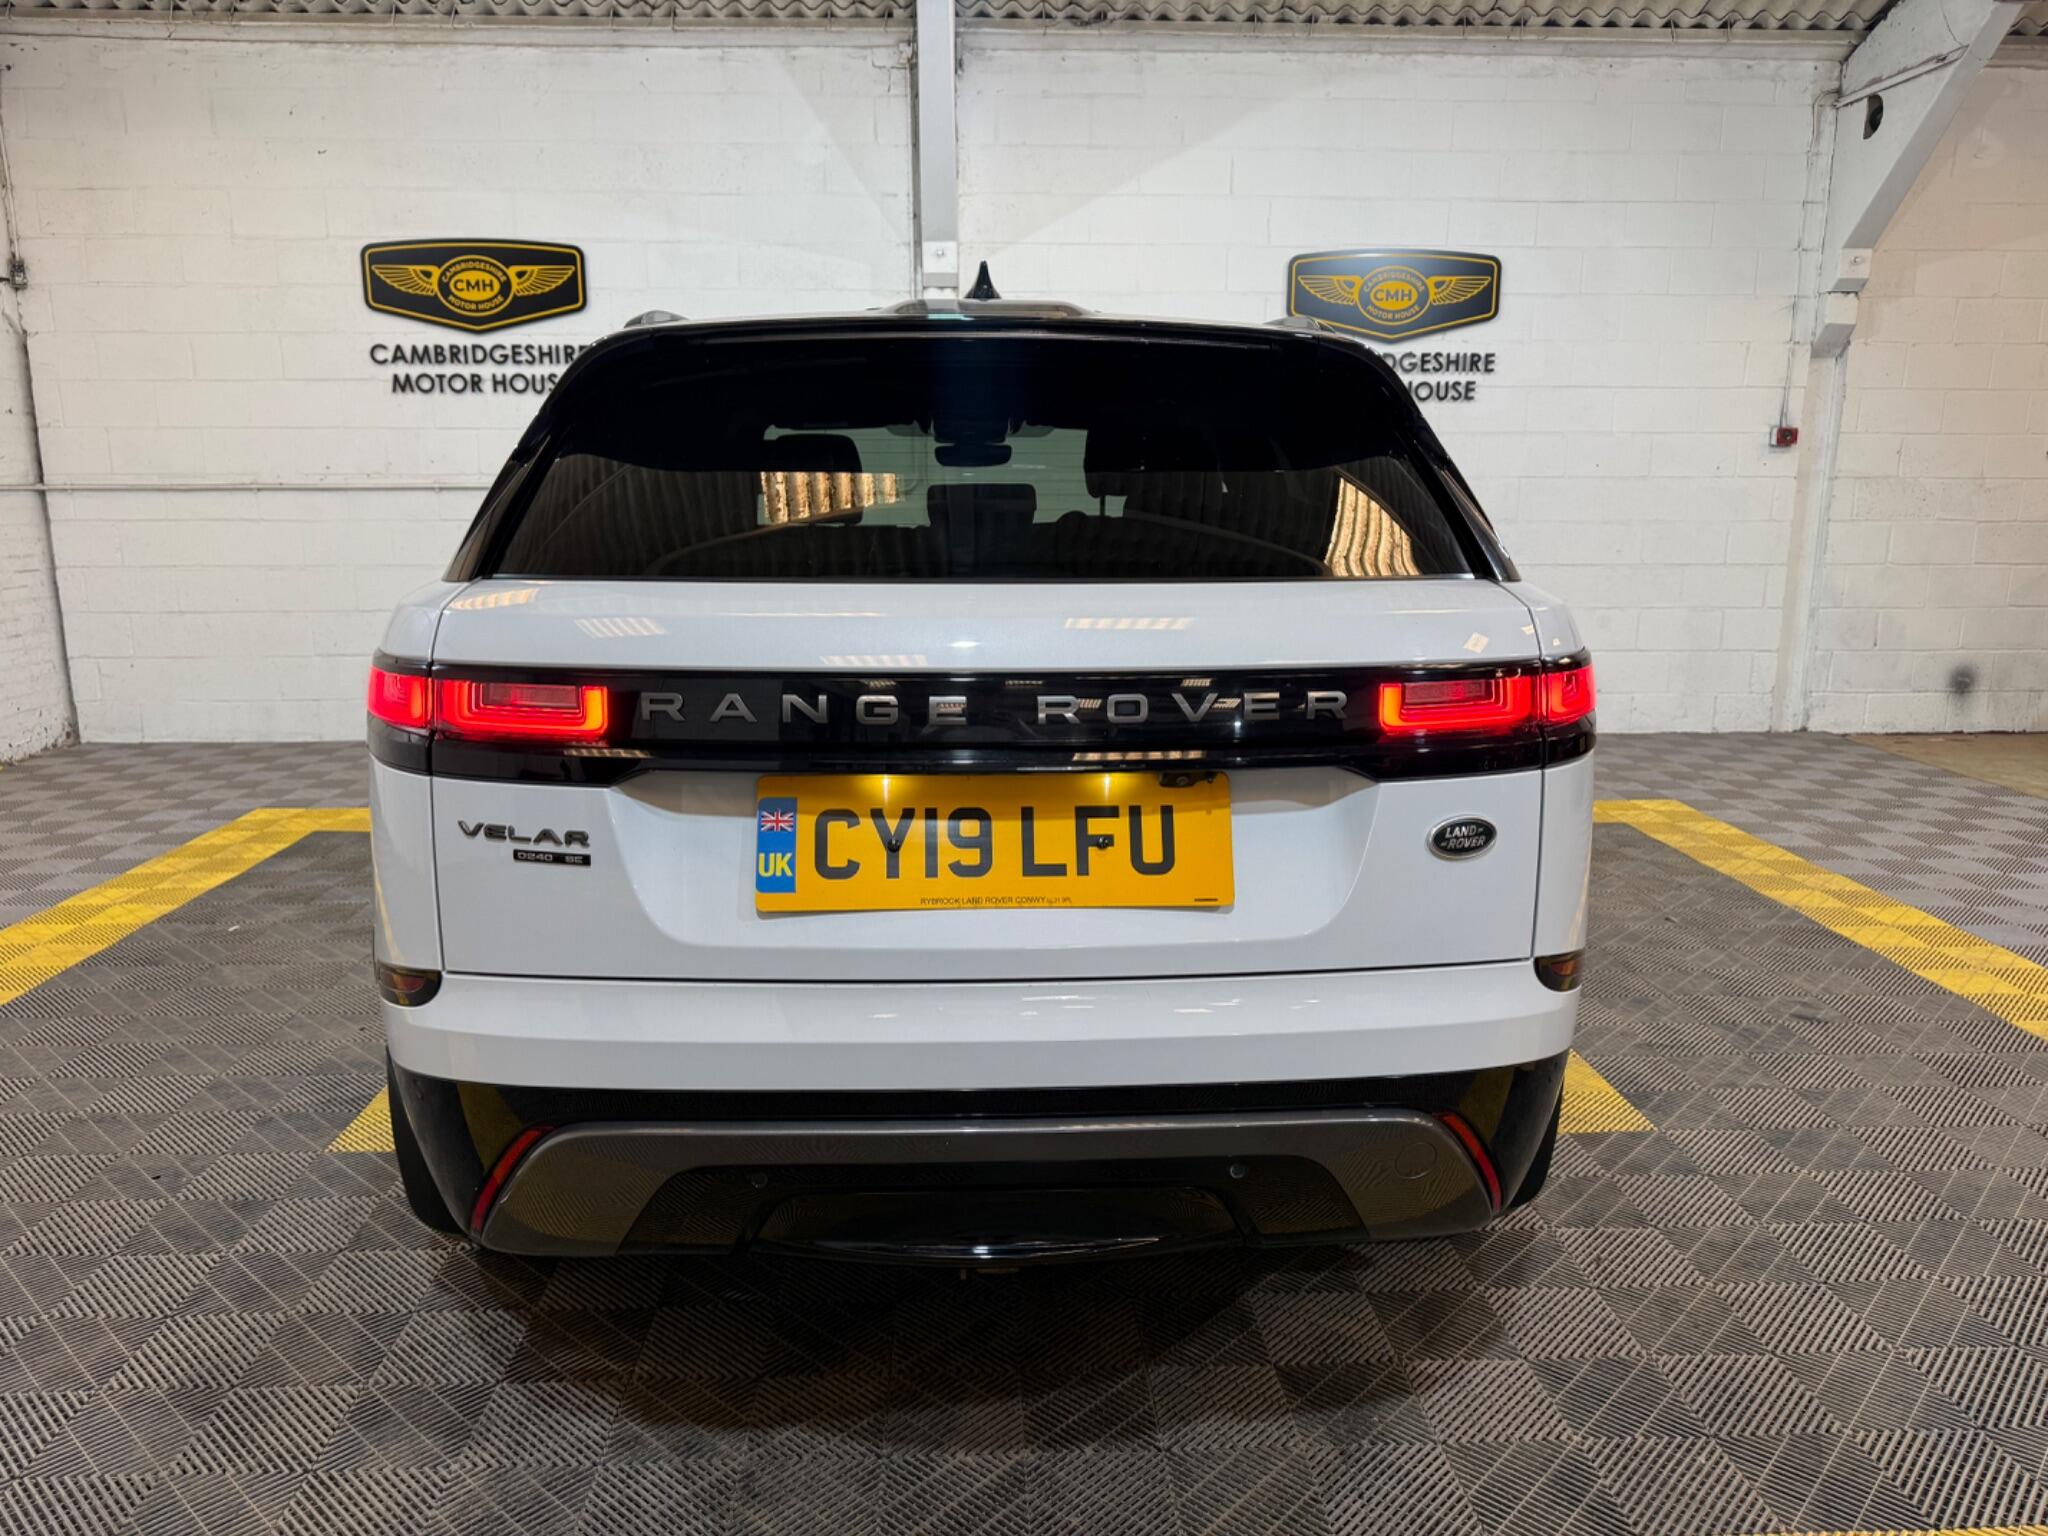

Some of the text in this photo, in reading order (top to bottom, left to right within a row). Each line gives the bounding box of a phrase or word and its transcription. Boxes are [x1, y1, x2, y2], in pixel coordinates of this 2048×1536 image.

[453, 279, 495, 292] CMH
[1374, 288, 1413, 302] CMH
[370, 344, 589, 366] CAMBRIDGESHIR
[1382, 352, 1496, 374] DGESHIRE
[392, 373, 558, 395] MOTOR HOUS
[1408, 380, 1476, 402] OUSE
[640, 692, 1348, 726] RANGE ROVER
[457, 820, 591, 848] VELAR
[814, 805, 1175, 880] CY19 LFU
[1445, 825, 1477, 838] LAND
[1447, 835, 1486, 849] ROVER
[517, 851, 553, 862] D240
[758, 852, 793, 878] UK
[962, 896, 983, 905] LAND
[985, 896, 1013, 904] ROVER
